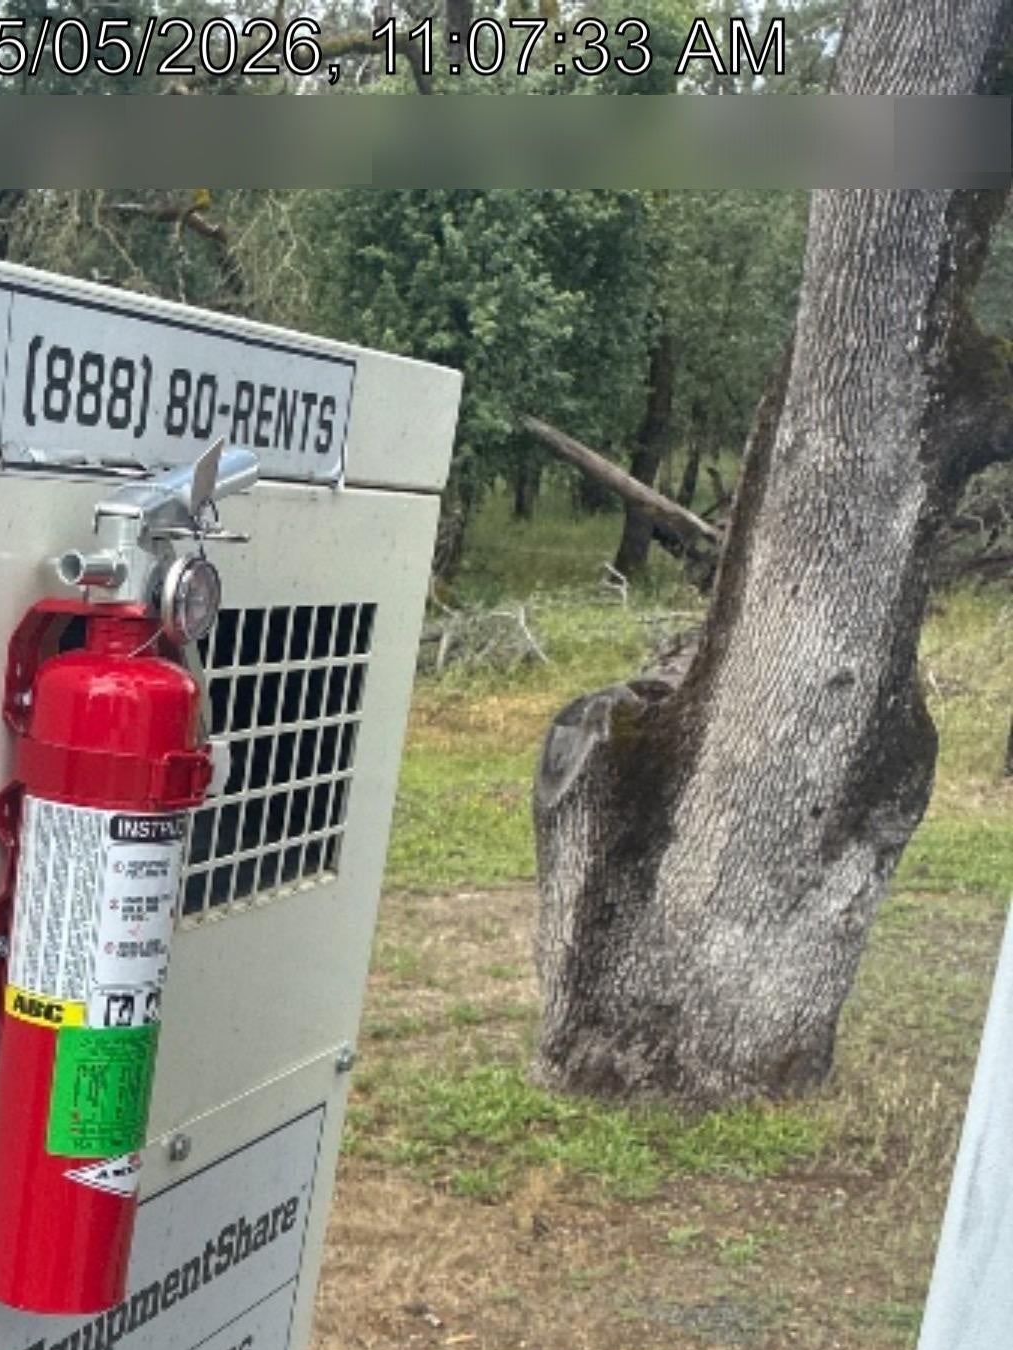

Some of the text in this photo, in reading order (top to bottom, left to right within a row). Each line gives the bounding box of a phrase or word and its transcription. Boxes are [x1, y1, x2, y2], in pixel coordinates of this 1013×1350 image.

[23, 334, 337, 455] (888) 80-RENTS
[13, 994, 64, 1023] ABC
